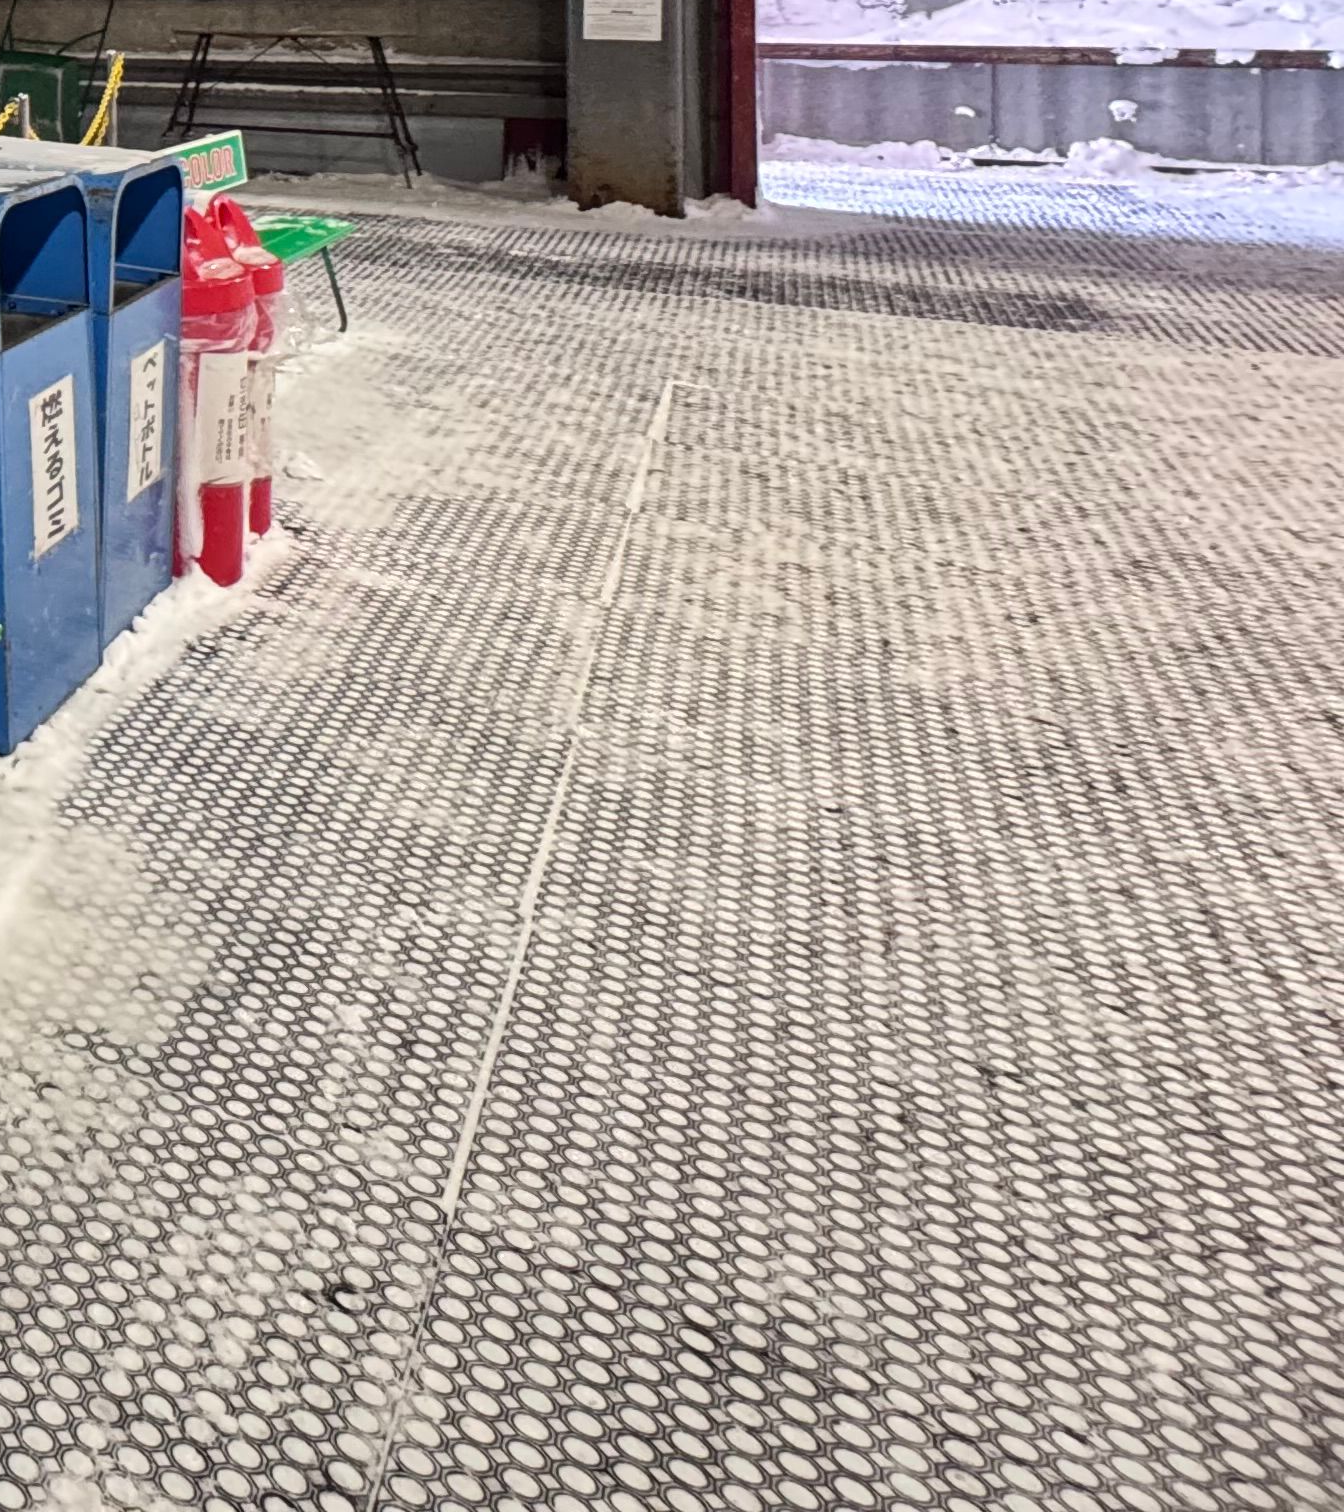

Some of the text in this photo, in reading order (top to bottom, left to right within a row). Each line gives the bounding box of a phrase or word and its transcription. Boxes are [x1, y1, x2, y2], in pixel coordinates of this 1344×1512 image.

[139, 351, 159, 487] ペットボトル
